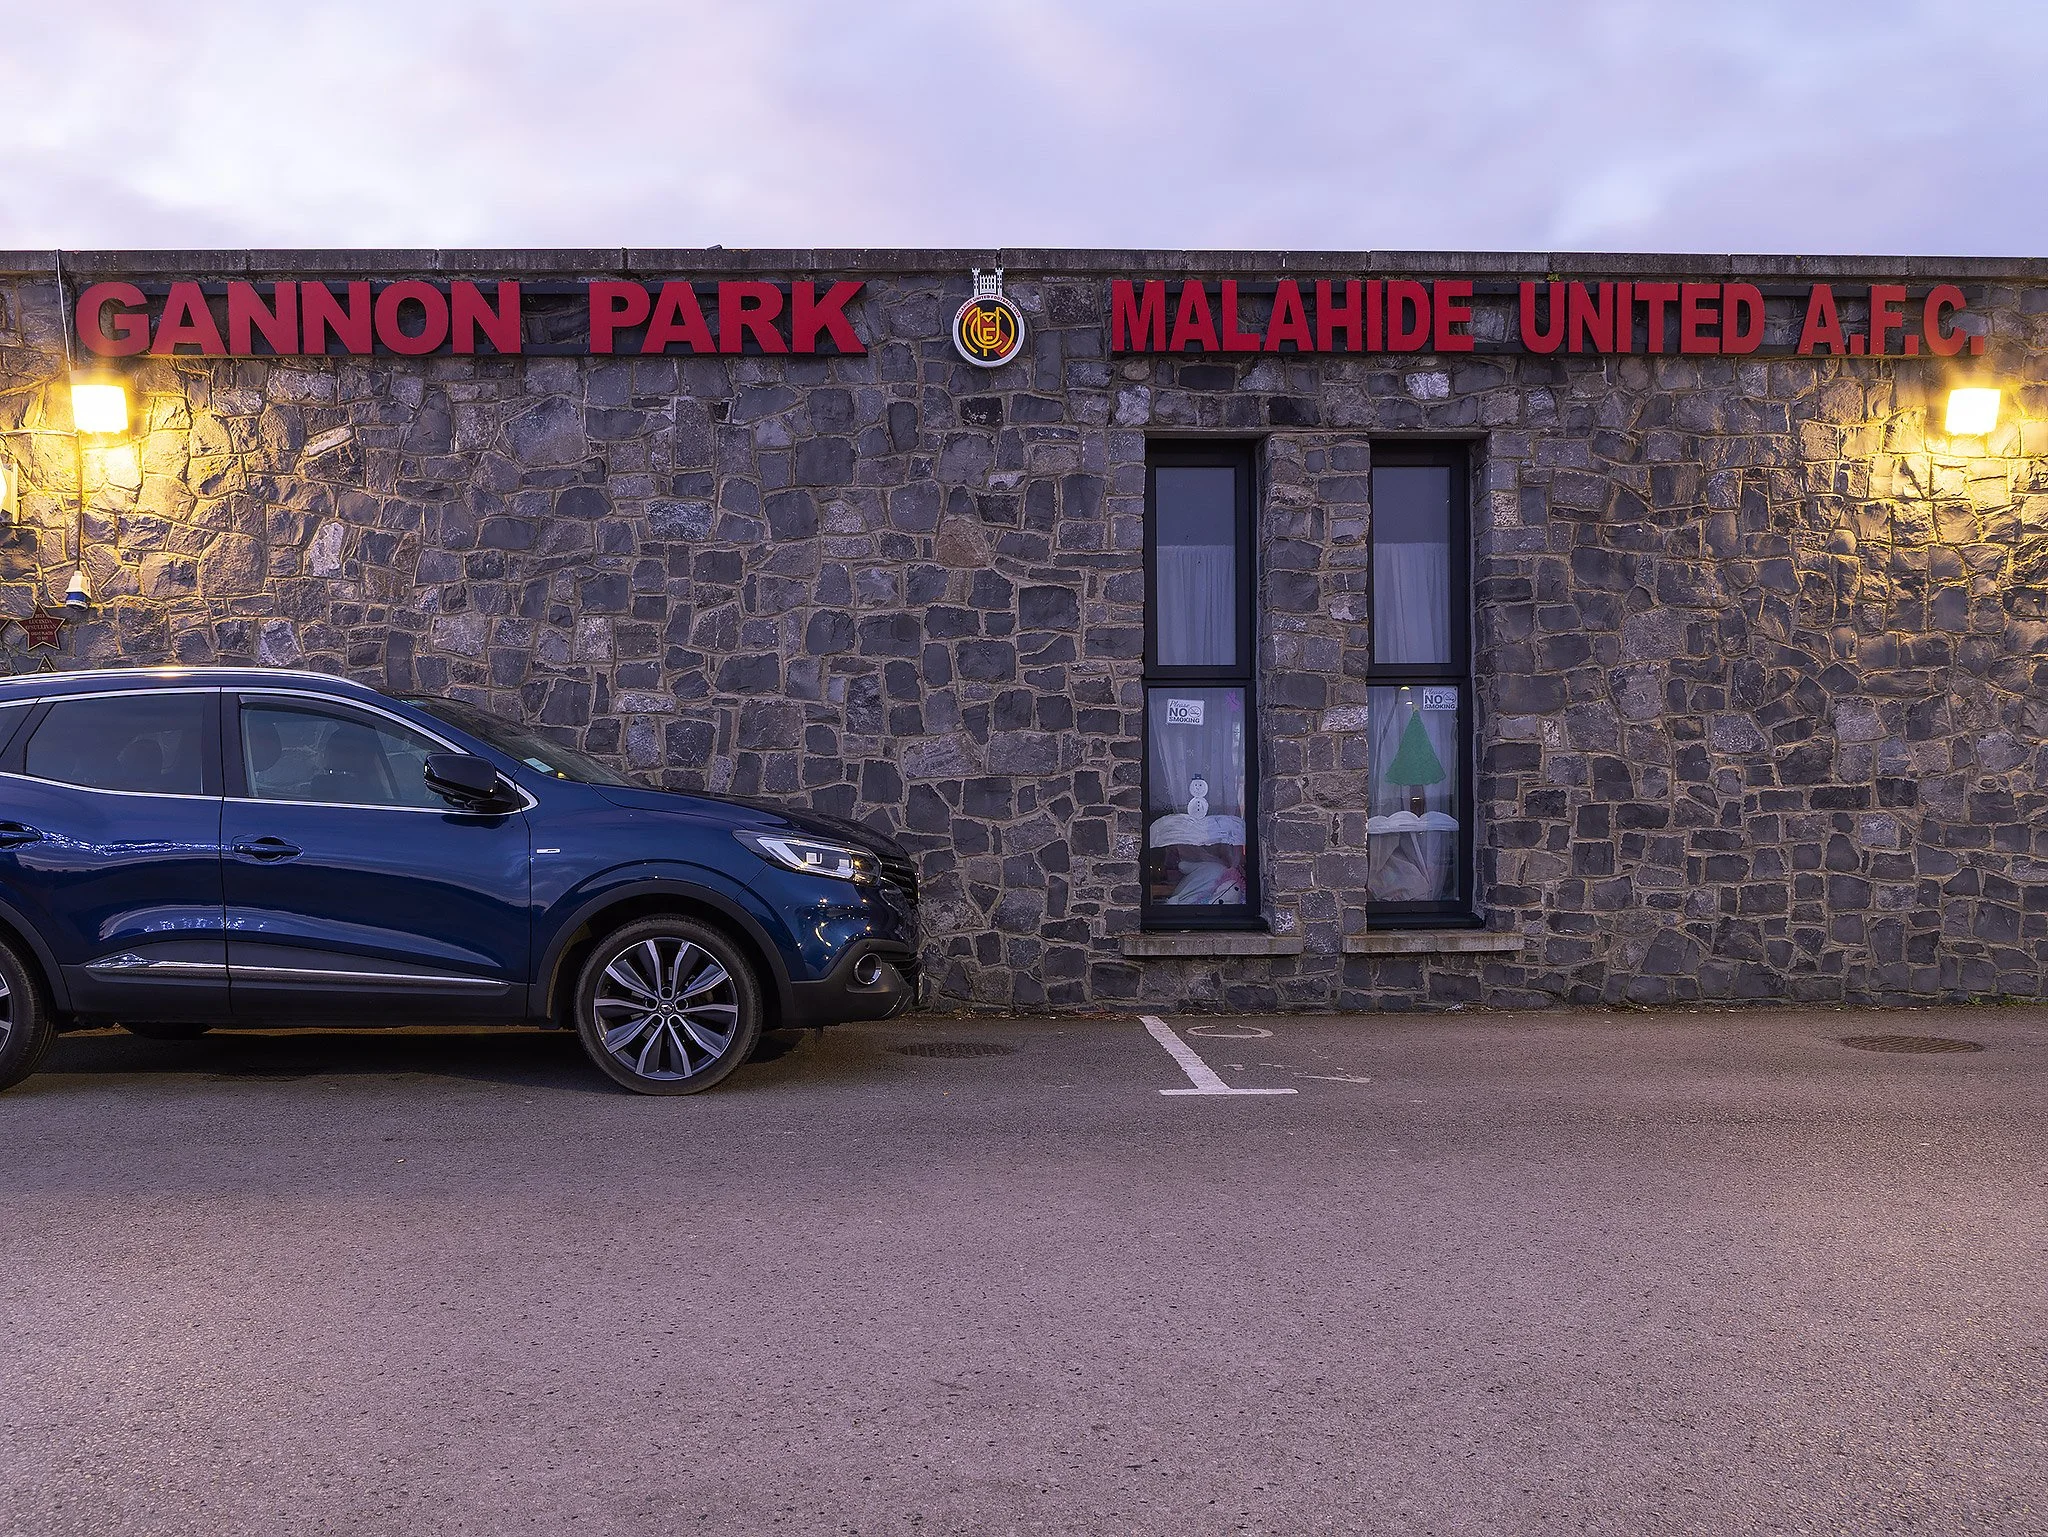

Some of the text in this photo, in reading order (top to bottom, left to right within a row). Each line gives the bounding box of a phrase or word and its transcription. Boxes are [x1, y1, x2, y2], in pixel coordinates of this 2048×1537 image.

[75, 280, 866, 357] GANNON PARK
[956, 300, 973, 319] MALAHIDE
[991, 295, 1013, 308] FOOTBALL
[1012, 306, 1021, 318] CLUB
[1111, 280, 1986, 356] MALAHIDE UNITED A.F.C.
[1425, 695, 1443, 704] NO
[1169, 707, 1188, 717] NO
